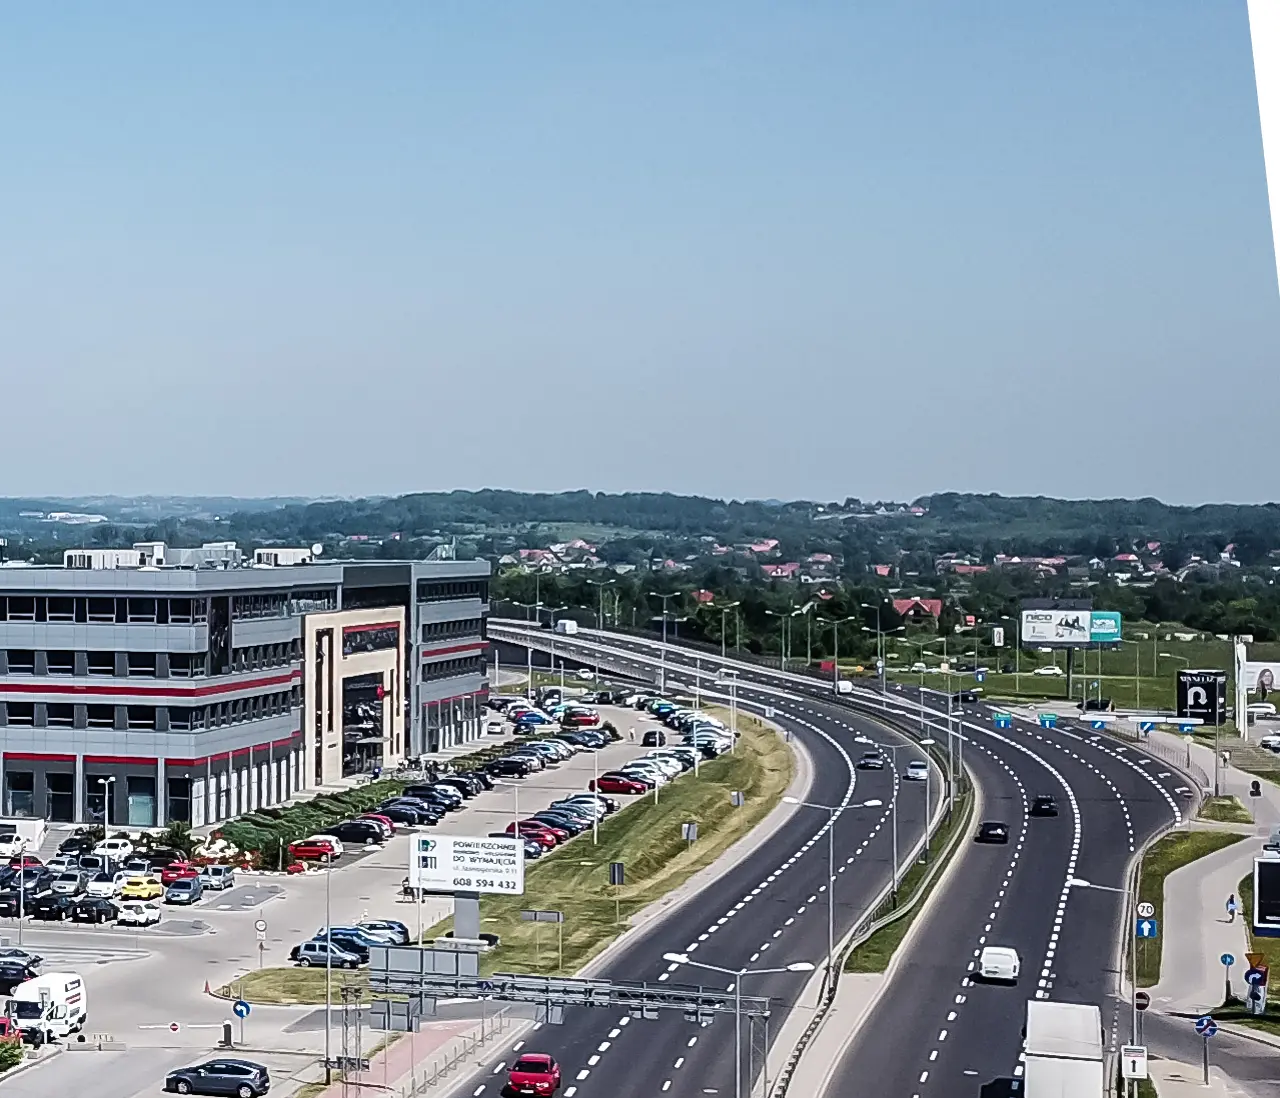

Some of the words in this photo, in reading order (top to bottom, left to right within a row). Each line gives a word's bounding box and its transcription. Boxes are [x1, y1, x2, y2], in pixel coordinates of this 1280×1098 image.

[453, 878, 472, 887] 608
[476, 879, 494, 888] 594
[498, 880, 517, 890] 432
[1140, 905, 1153, 914] 70
